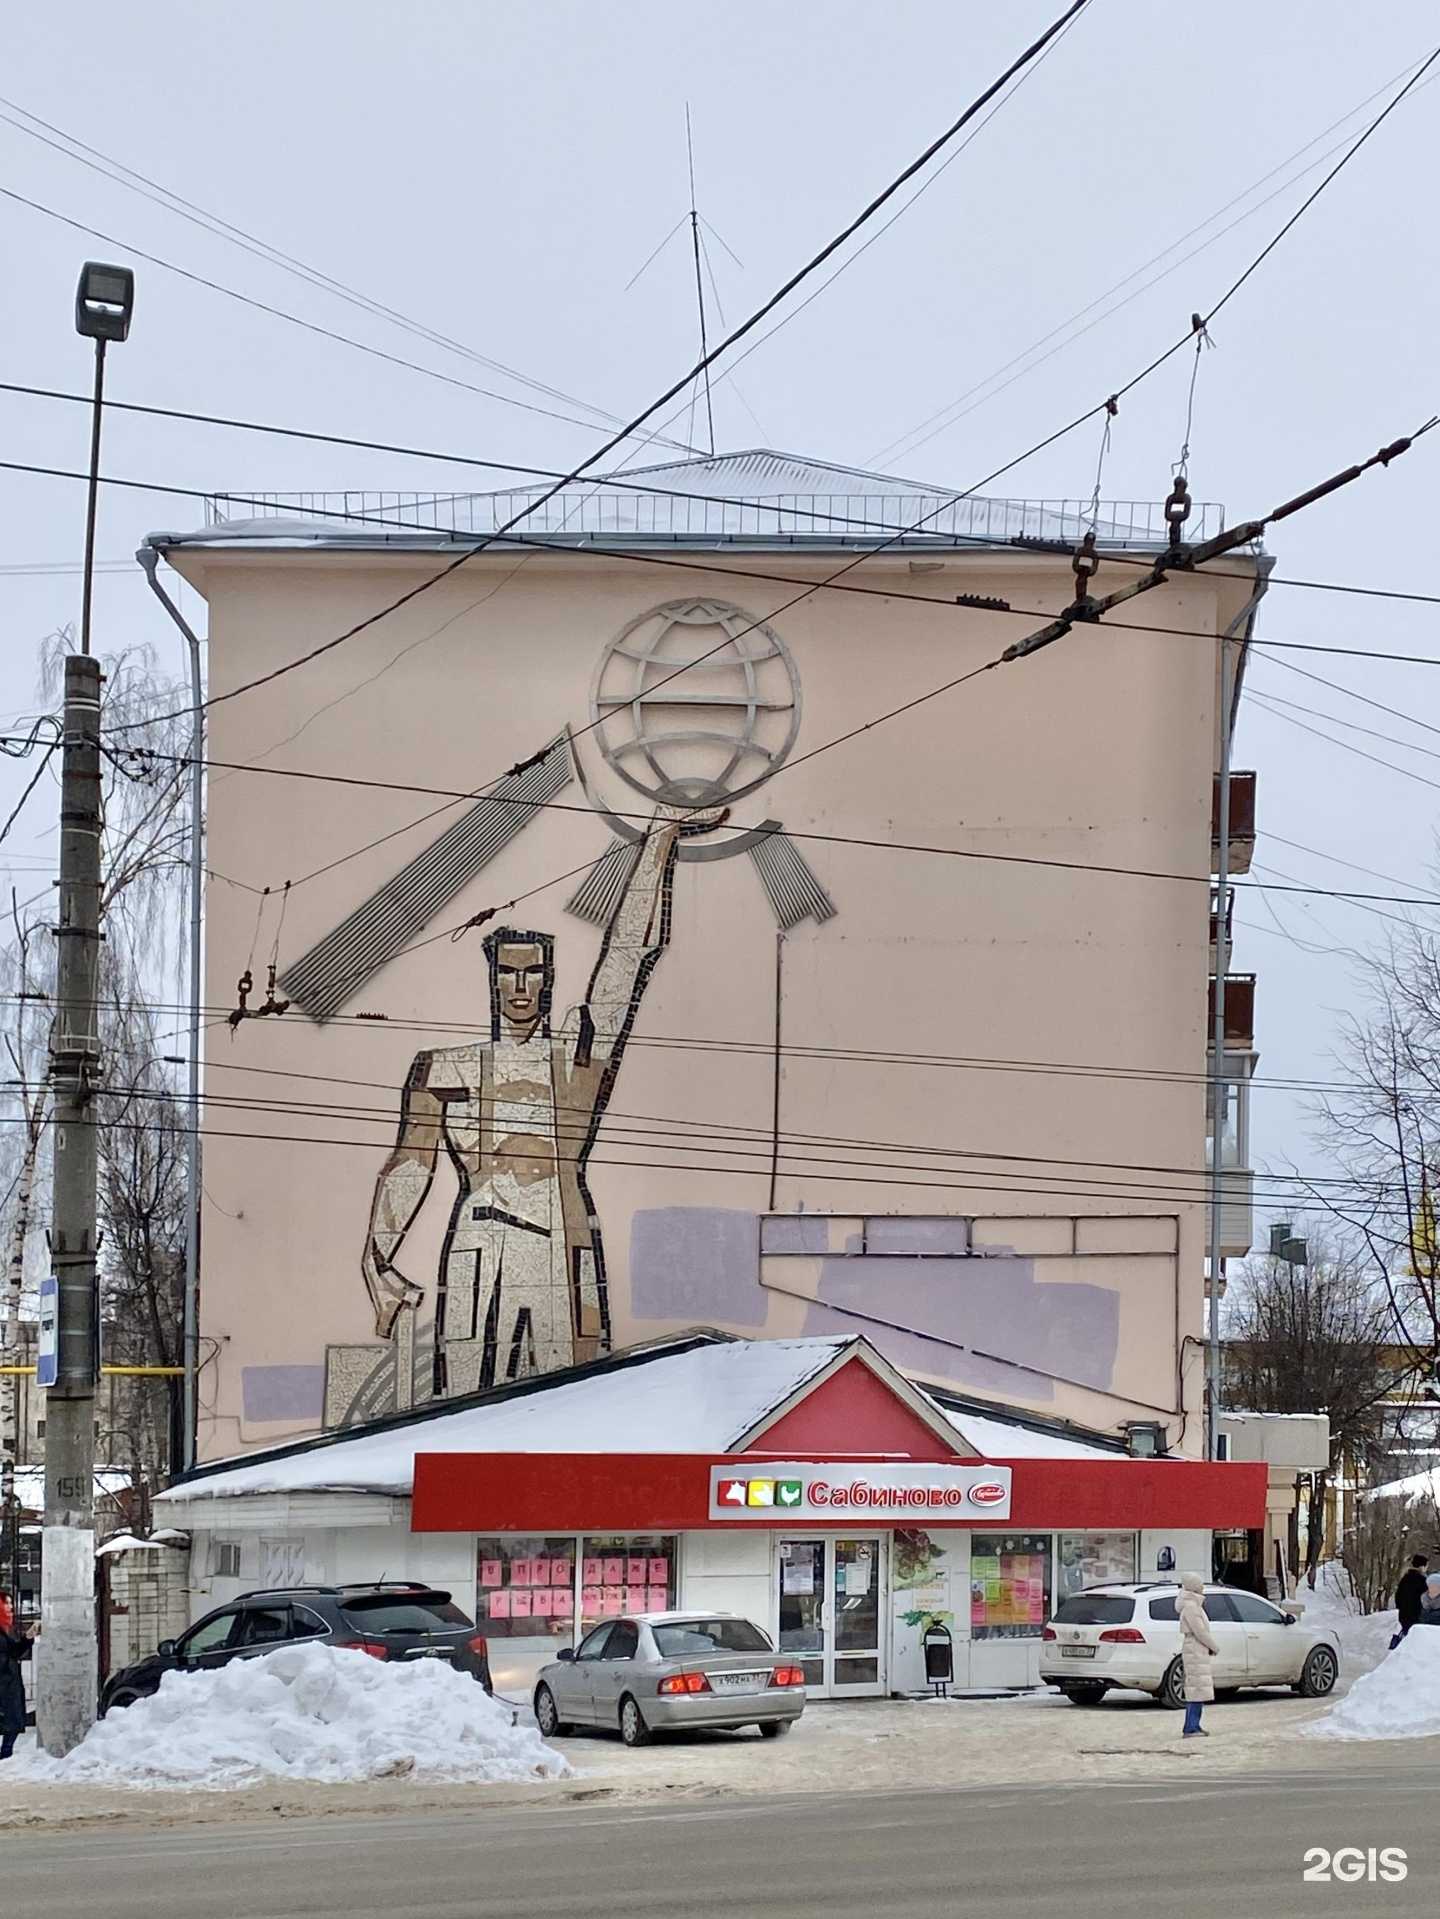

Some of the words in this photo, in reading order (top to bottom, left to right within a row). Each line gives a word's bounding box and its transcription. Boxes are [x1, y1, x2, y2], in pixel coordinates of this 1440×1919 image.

[57, 1476, 85, 1497] 159
[808, 1479, 962, 1507] Сабиново
[517, 1563, 662, 1574] ПРОДАЖЕ
